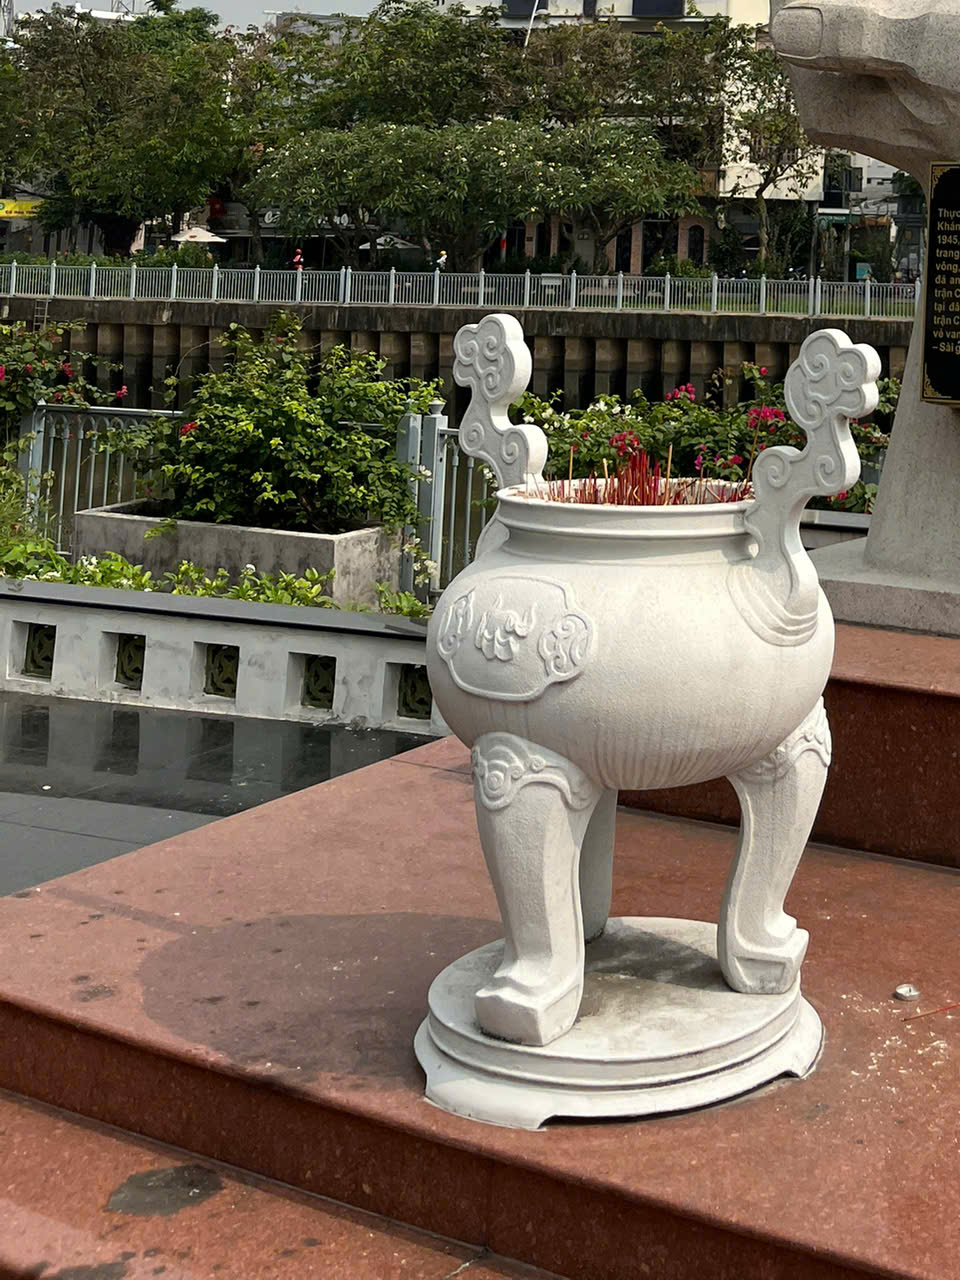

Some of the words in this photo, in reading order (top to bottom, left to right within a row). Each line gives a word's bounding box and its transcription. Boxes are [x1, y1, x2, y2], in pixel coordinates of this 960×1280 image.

[938, 208, 960, 219] Thực
[937, 235, 960, 245] 1945,
[936, 248, 960, 260] trang
[935, 288, 952, 300] trận
[934, 302, 945, 313] tại
[934, 315, 952, 326] trận
[939, 342, 954, 352] Sài
